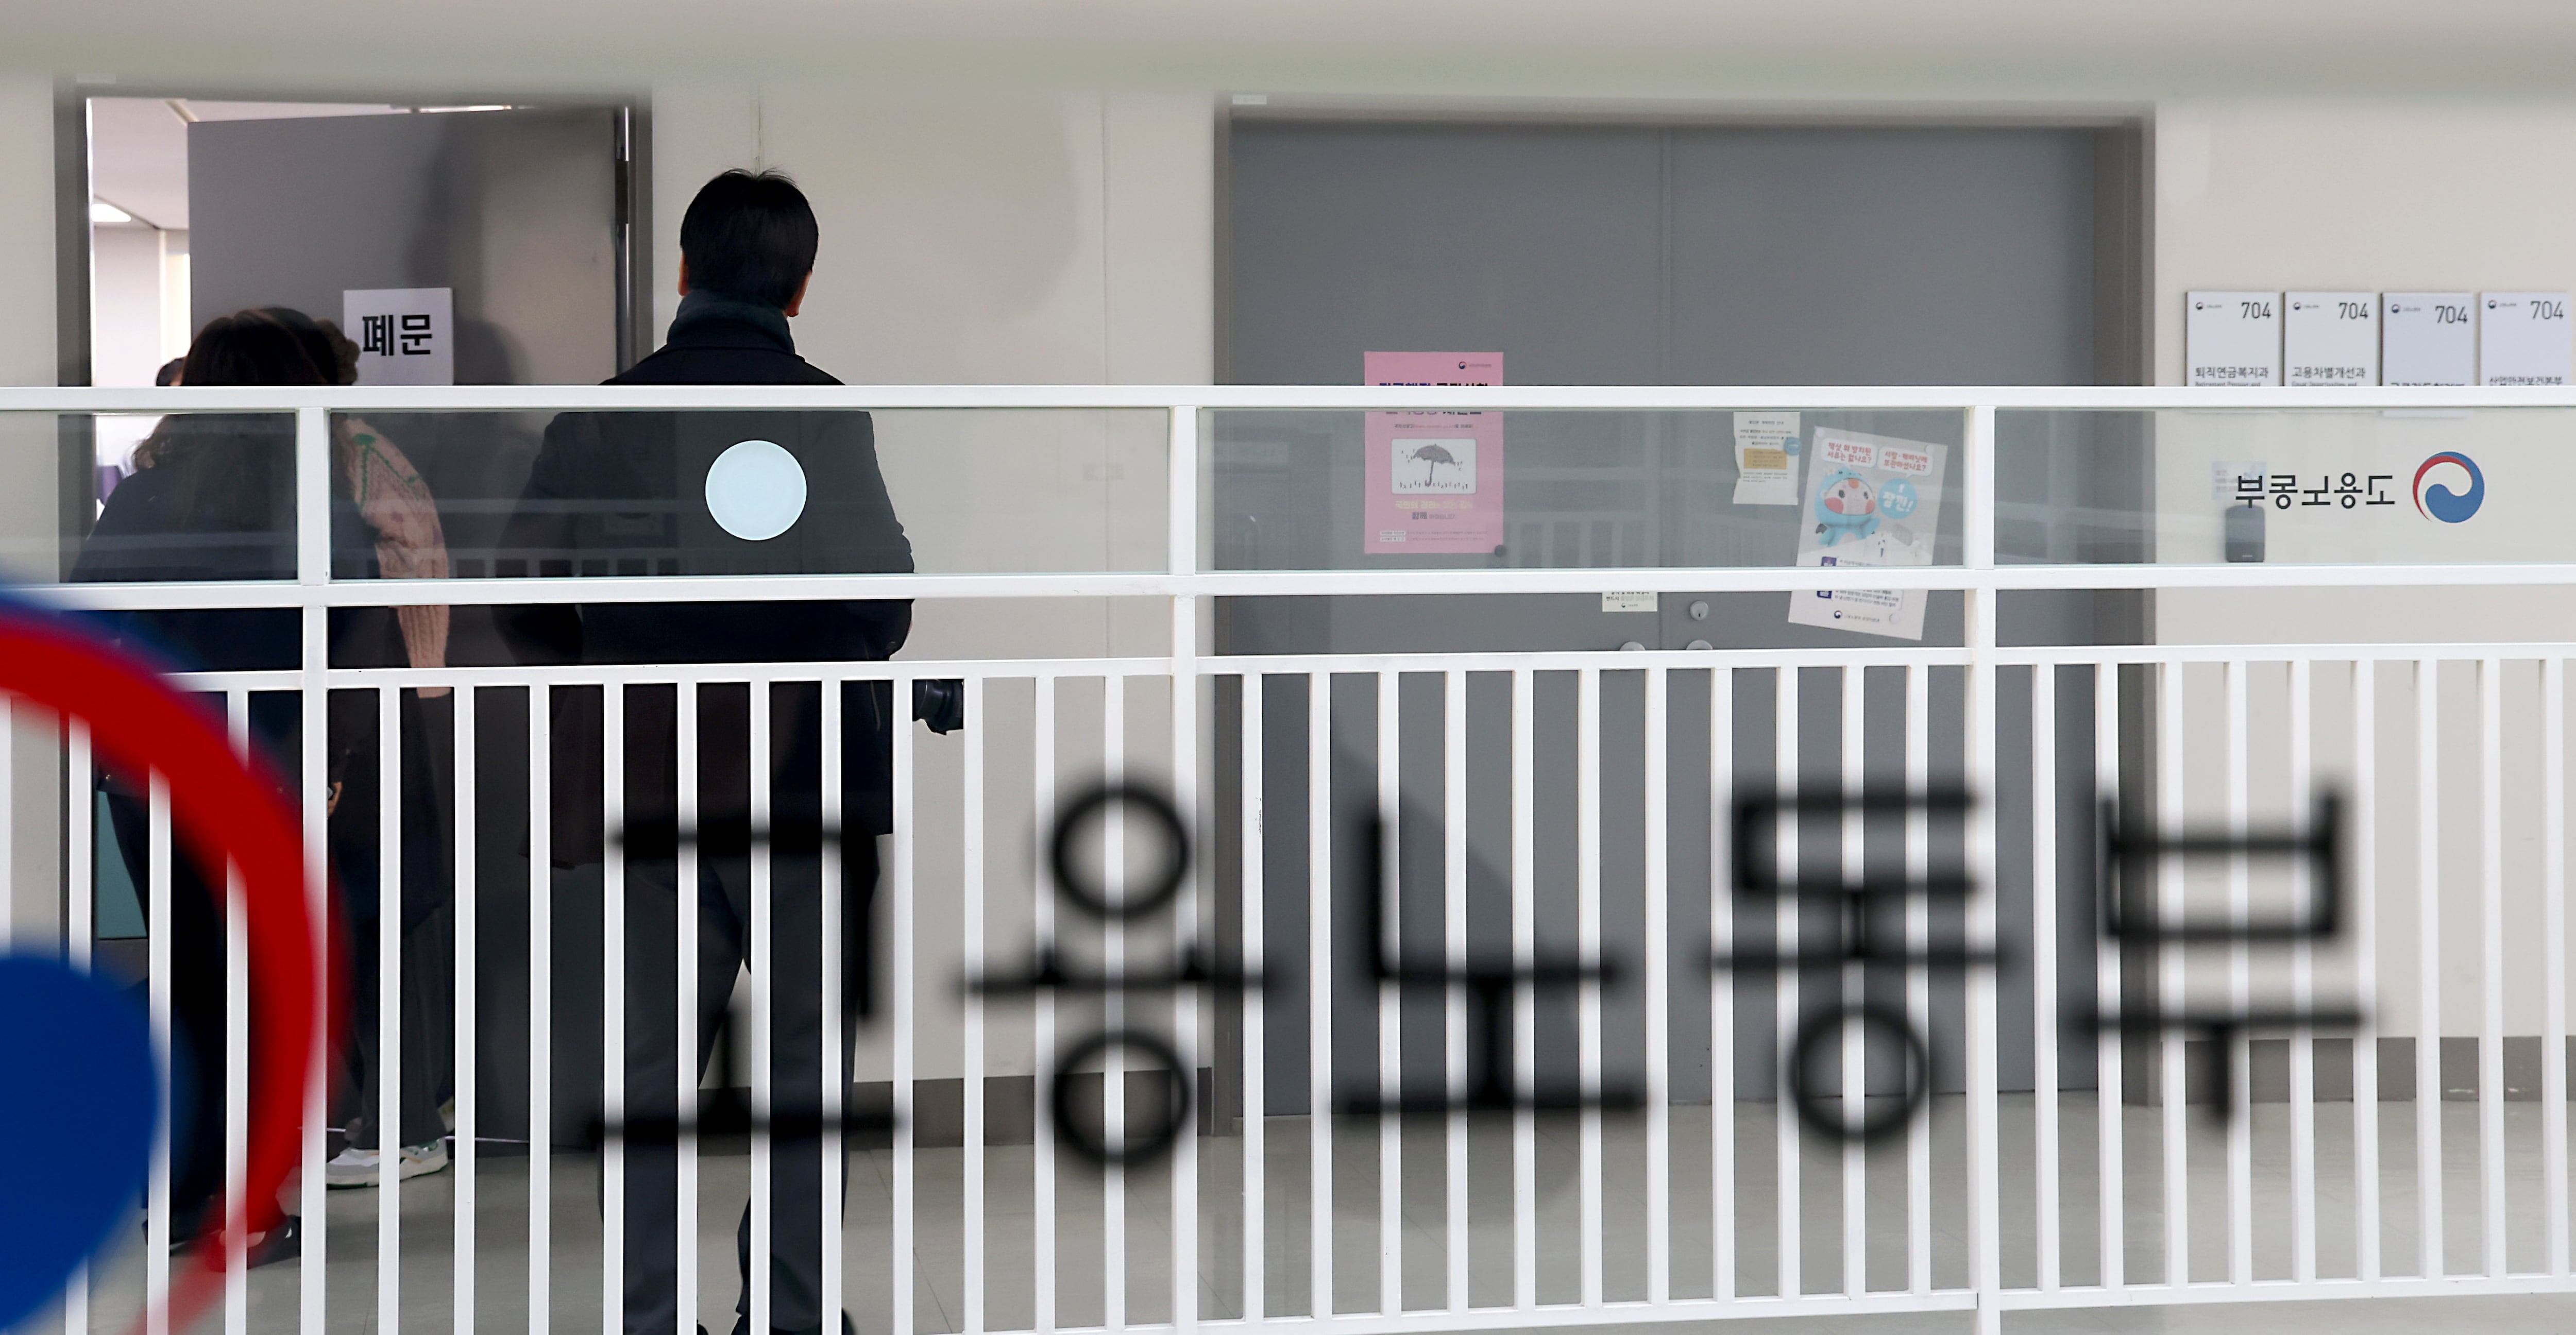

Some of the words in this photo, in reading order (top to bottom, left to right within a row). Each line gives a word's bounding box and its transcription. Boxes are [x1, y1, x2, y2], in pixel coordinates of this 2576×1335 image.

[2242, 302, 2271, 318] 704
[2339, 302, 2368, 319] 704
[2435, 306, 2468, 324] 704
[2531, 301, 2564, 319] 704
[362, 314, 432, 356] 폐문
[2195, 367, 2269, 378] 퇴직연금복지과
[2292, 367, 2366, 379] 고용차별개선과
[590, 775, 2370, 1167] 고용노동부
